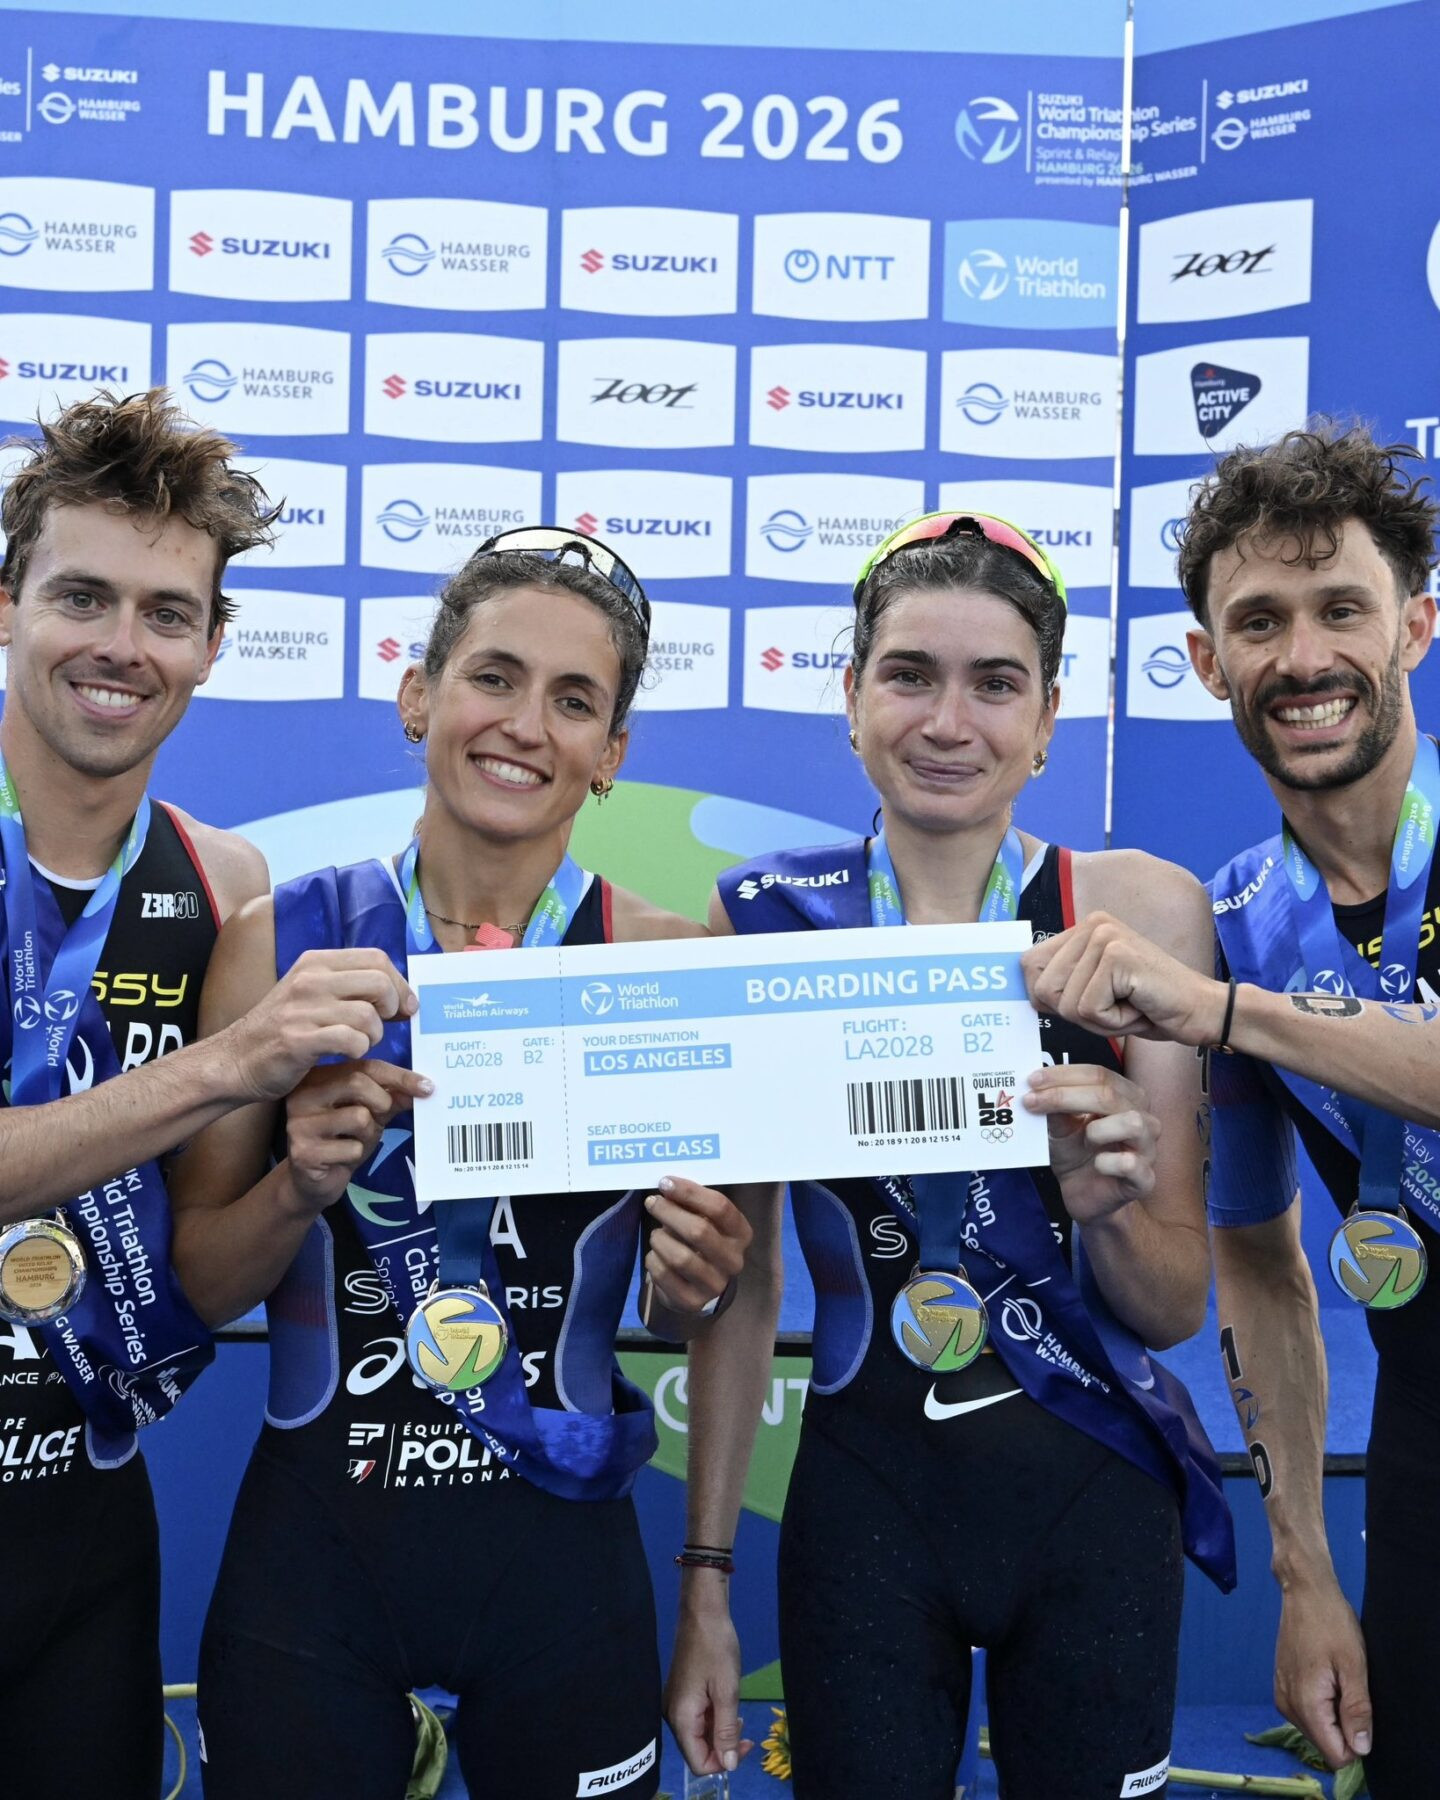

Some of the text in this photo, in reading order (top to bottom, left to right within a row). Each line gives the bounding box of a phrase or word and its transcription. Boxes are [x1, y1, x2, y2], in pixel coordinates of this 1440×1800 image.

[64, 67, 138, 84] SUZUKI
[1037, 93, 1084, 106] SUZUKI
[1236, 79, 1309, 104] SUZUKI
[78, 98, 141, 112] HAMBURG
[1037, 106, 1086, 122] World
[79, 110, 126, 122] WASSER
[208, 70, 904, 164] HAMBURG 2026
[1250, 109, 1312, 129] HAMBURG
[1150, 116, 1198, 138] Series
[1250, 122, 1297, 140] WASSER
[1036, 147, 1120, 163] Sprint & Relay
[1036, 161, 1105, 175] HAMBURG
[1155, 166, 1198, 182] WASSER
[44, 221, 138, 239] HAMBURG
[45, 237, 116, 254] WASSER
[221, 237, 331, 260] SUZUKI
[441, 241, 531, 259] HAMBURG
[441, 256, 510, 273] WASSER
[611, 254, 718, 273] SUZUKI
[826, 254, 896, 281] NTT
[1014, 255, 1079, 276] World
[1014, 275, 1106, 300] Triathlon
[18, 361, 129, 383] SUZUKI
[243, 367, 335, 385] HAMBURG
[243, 383, 314, 400] WASSER
[414, 379, 522, 401] SUZUKI
[1013, 389, 1102, 406] HAMBURG
[1197, 387, 1251, 407] ACTIVE
[798, 390, 904, 411] SUZUKI
[1014, 404, 1082, 421] WASSER
[1198, 405, 1233, 422] CITY
[435, 507, 525, 523] HAMBURG
[605, 517, 712, 537] SUZUKI
[1026, 529, 1093, 547] ZUKI
[238, 629, 329, 646] HAMBURG
[238, 645, 308, 661] WASSER
[654, 657, 694, 671] SSER
[1399, 802, 1419, 873] extraordinary
[1417, 818, 1428, 843] your
[760, 868, 849, 888] SUZUKI
[1212, 857, 1275, 916] SUZUKI
[15, 949, 23, 992] World
[25, 931, 34, 992] Triathlon
[617, 982, 660, 997] World
[745, 965, 1009, 1004] BOARDING PASS
[617, 993, 679, 1011] Triathlon
[443, 1007, 529, 1019] Triathlon Airways
[48, 1025, 67, 1067] World
[582, 1030, 700, 1048] YOUR DESTINATION
[844, 1035, 934, 1061] LA2028
[963, 1031, 994, 1053] B2
[445, 1052, 503, 1069] LA2028
[524, 1050, 544, 1064] B2
[589, 1048, 725, 1072] LOS ANGELES
[973, 1076, 1015, 1090] QUALIFIER
[447, 1092, 524, 1109] JULY 2028
[979, 1108, 1014, 1127] 28
[587, 1122, 672, 1137] SEAT BOOKED
[593, 1139, 714, 1161] FIRST CLASS
[113, 1203, 156, 1306] Triathlon
[16, 1273, 55, 1283] HAMBURG
[114, 1299, 147, 1364] Series
[61, 1327, 95, 1385] WASSER
[403, 1422, 472, 1438] ÉQUIP
[587, 1750, 653, 1790] Alltricks
